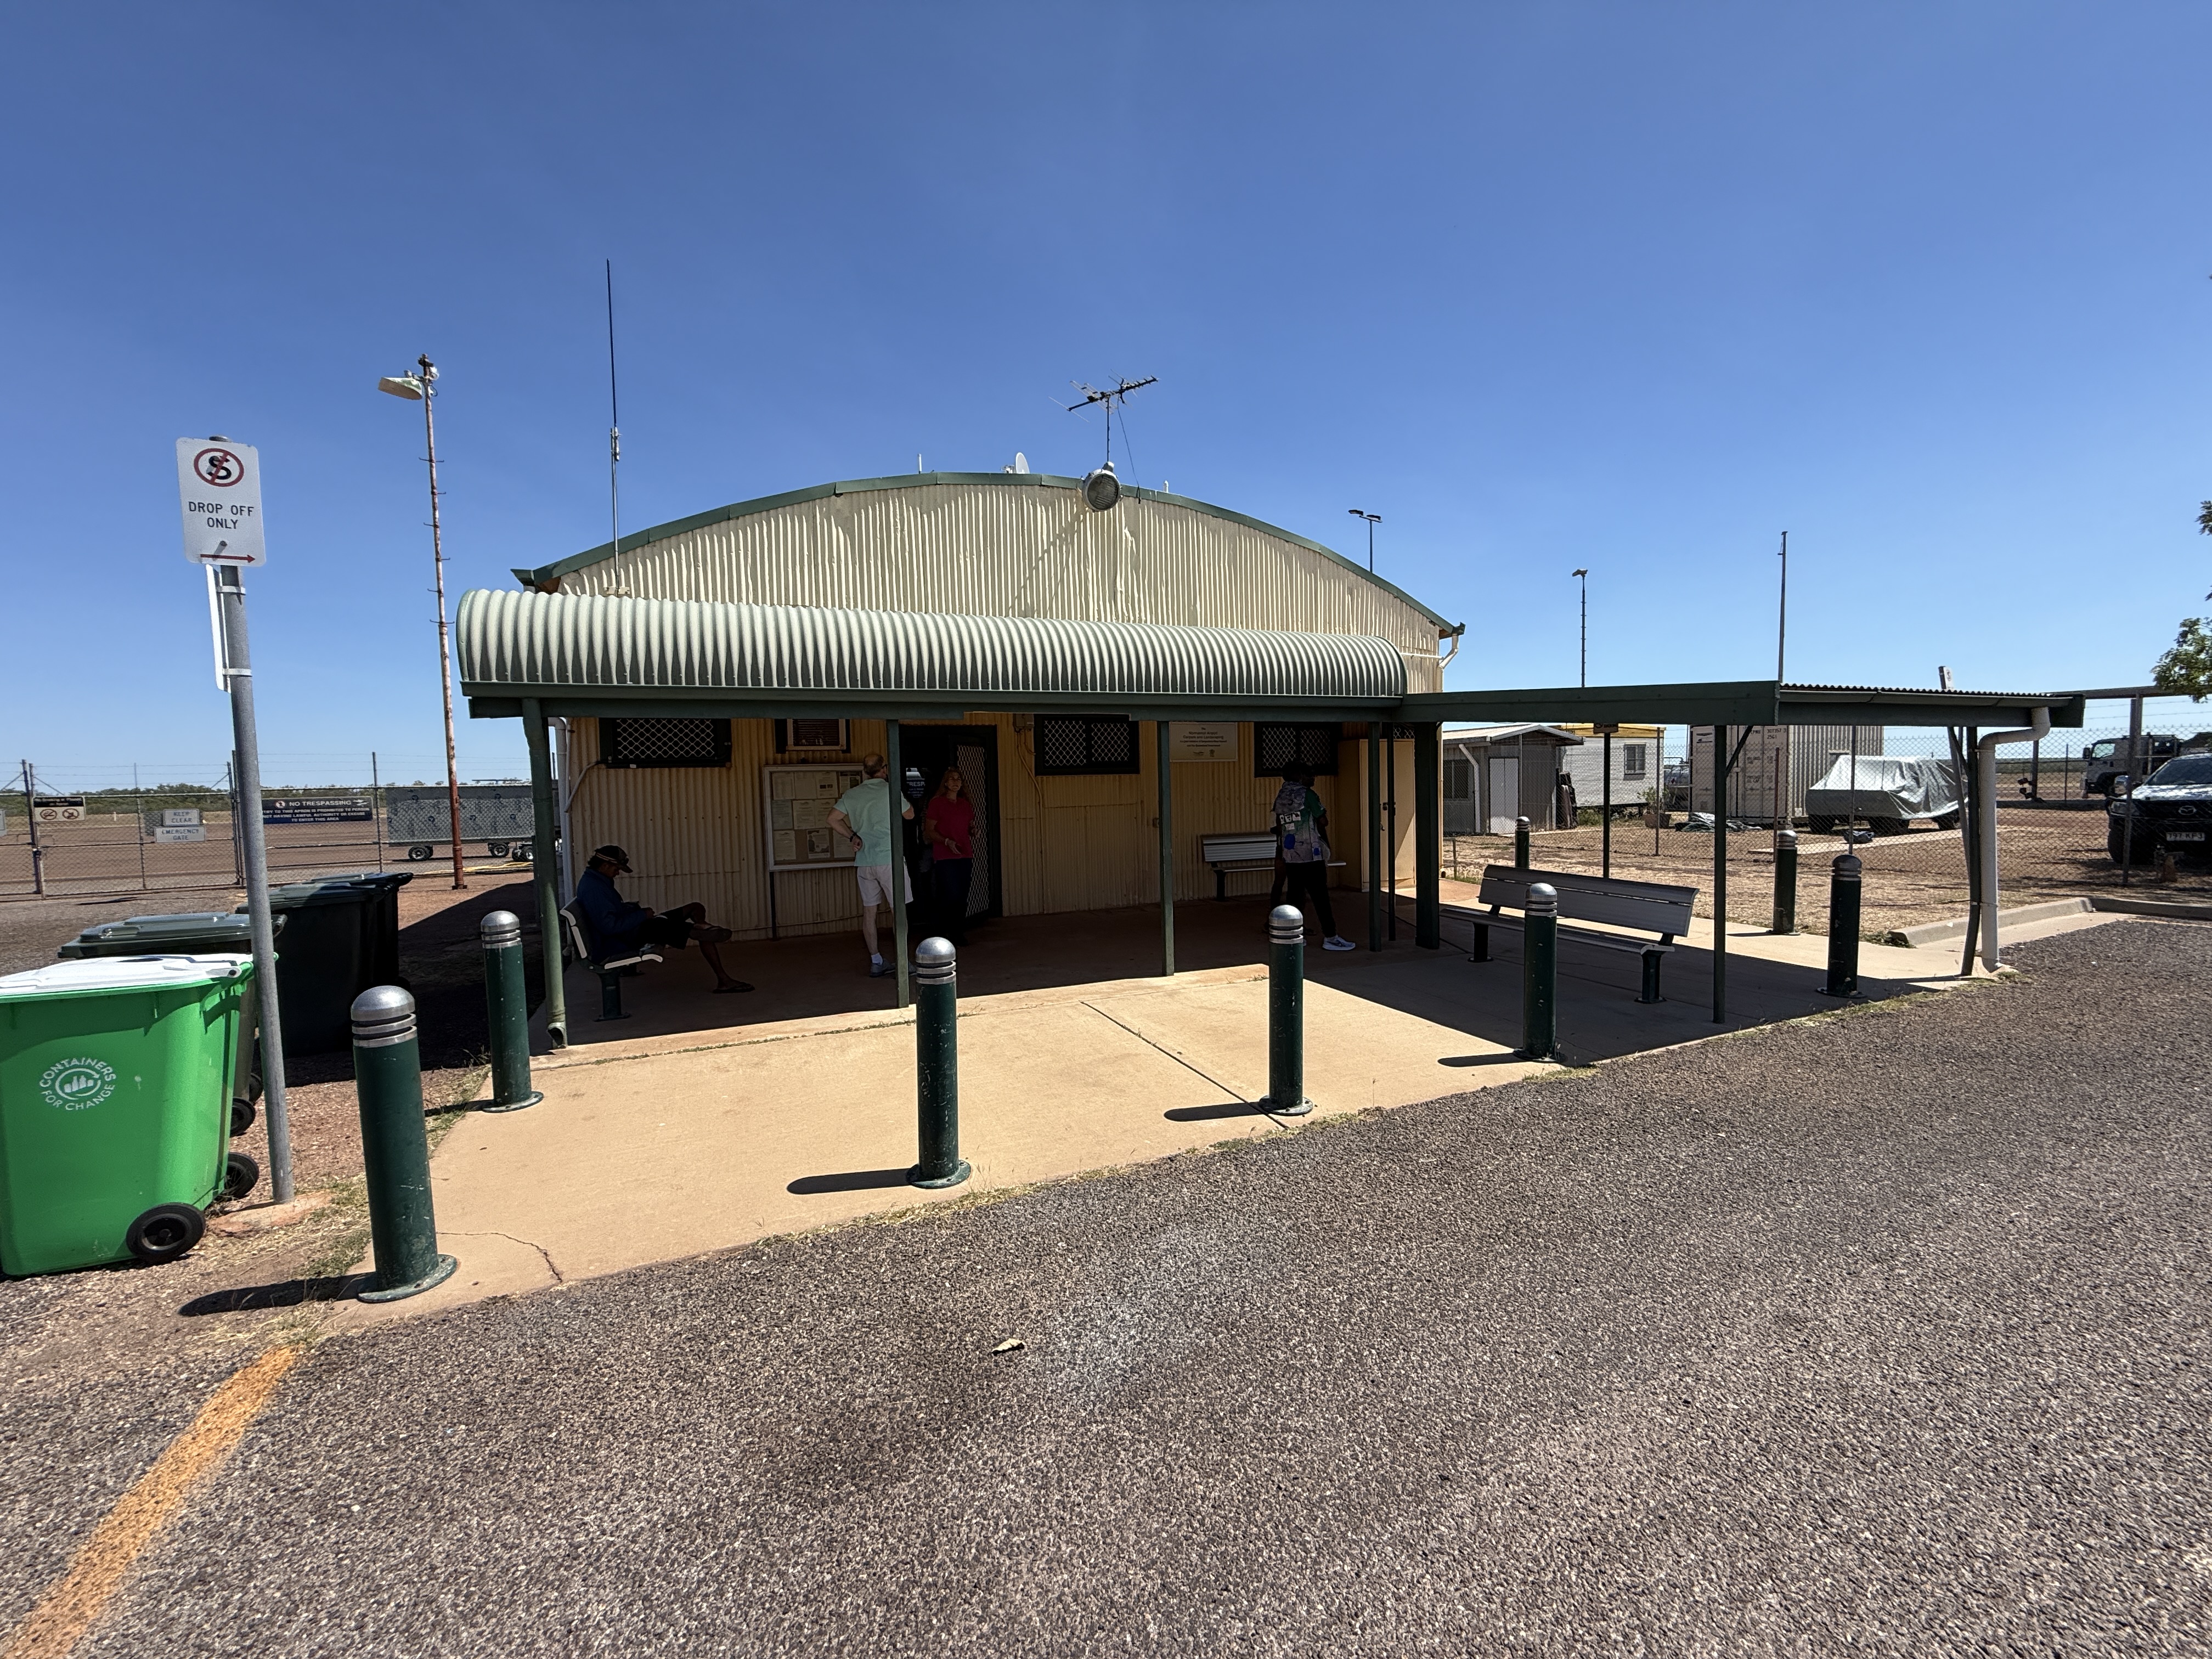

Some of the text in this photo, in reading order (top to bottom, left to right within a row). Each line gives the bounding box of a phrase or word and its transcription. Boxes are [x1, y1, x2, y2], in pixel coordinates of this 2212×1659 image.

[188, 501, 254, 516] DROP OFF
[207, 517, 238, 529] ONLY
[40, 1057, 116, 1087] CONTAINERS
[41, 1084, 116, 1110] FOR CHANGE
